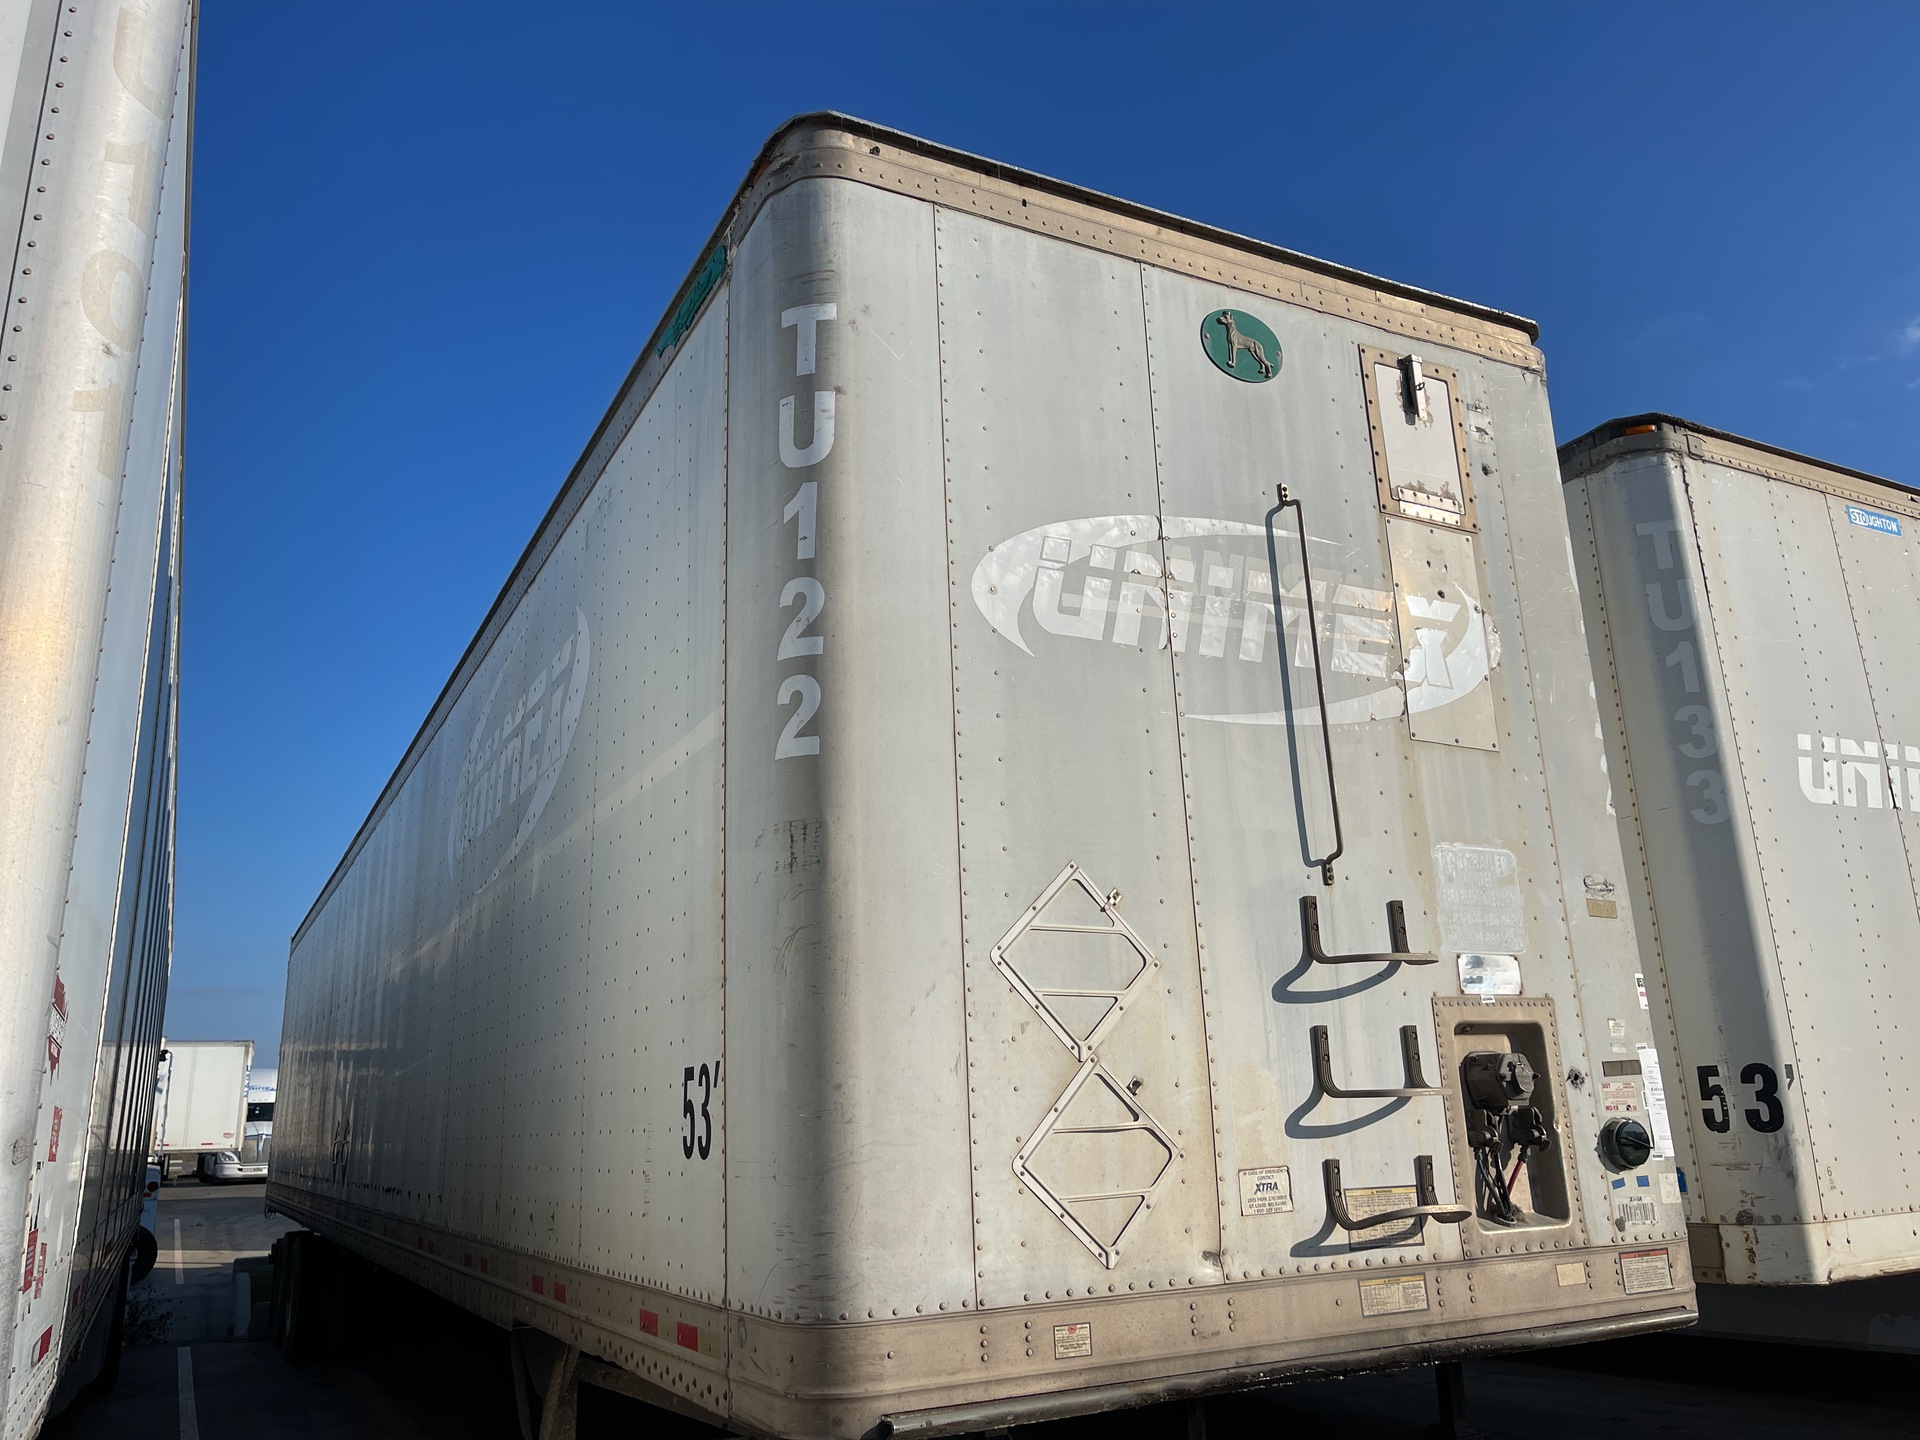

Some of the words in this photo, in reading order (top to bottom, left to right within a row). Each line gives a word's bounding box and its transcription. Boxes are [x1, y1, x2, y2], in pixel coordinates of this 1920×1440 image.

[774, 302, 838, 761] TU122
[1850, 510, 1898, 533] STOUGHTON
[1635, 518, 1732, 825] TU133
[682, 1060, 720, 1160] 53'
[1254, 1182, 1278, 1195] XTRA
